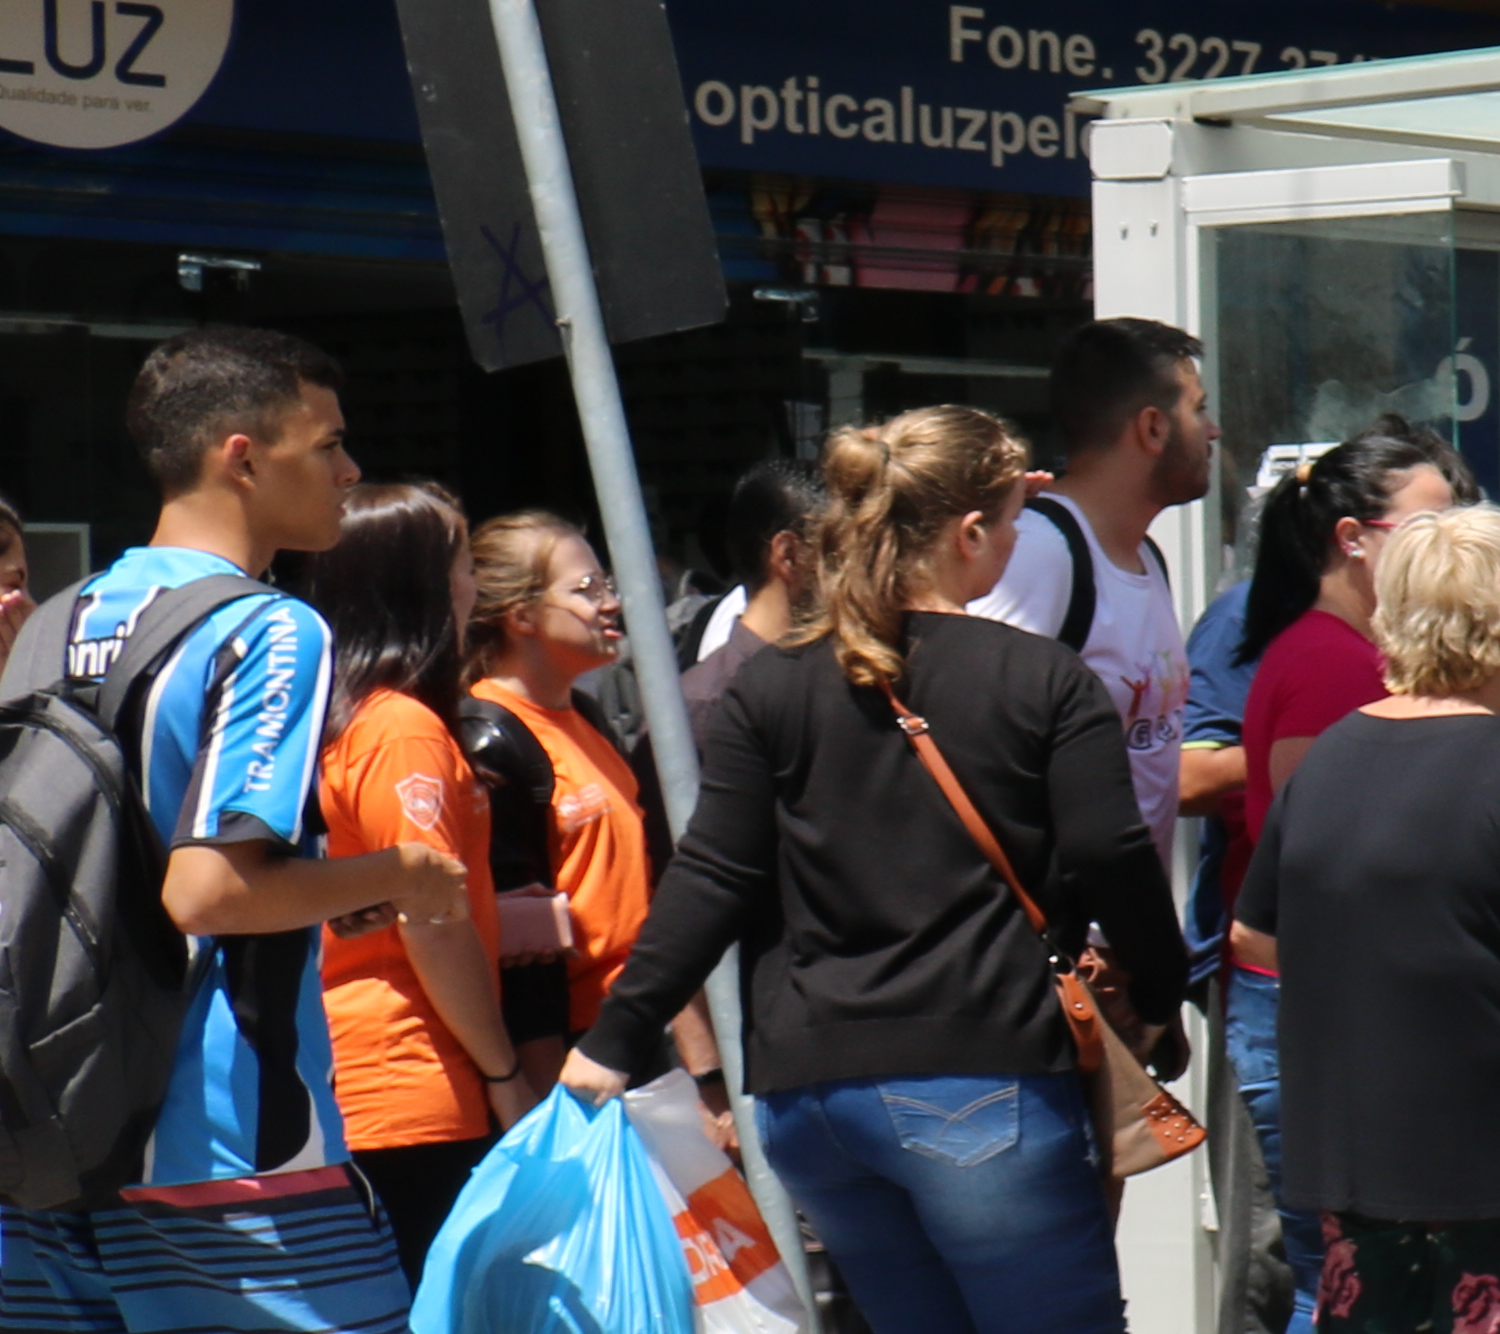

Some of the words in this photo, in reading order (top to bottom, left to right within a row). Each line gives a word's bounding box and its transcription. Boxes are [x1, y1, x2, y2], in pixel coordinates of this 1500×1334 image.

[948, 5, 1113, 80] Fone.
[82, 95, 120, 111] para
[244, 606, 299, 793] TRAMONTINA
